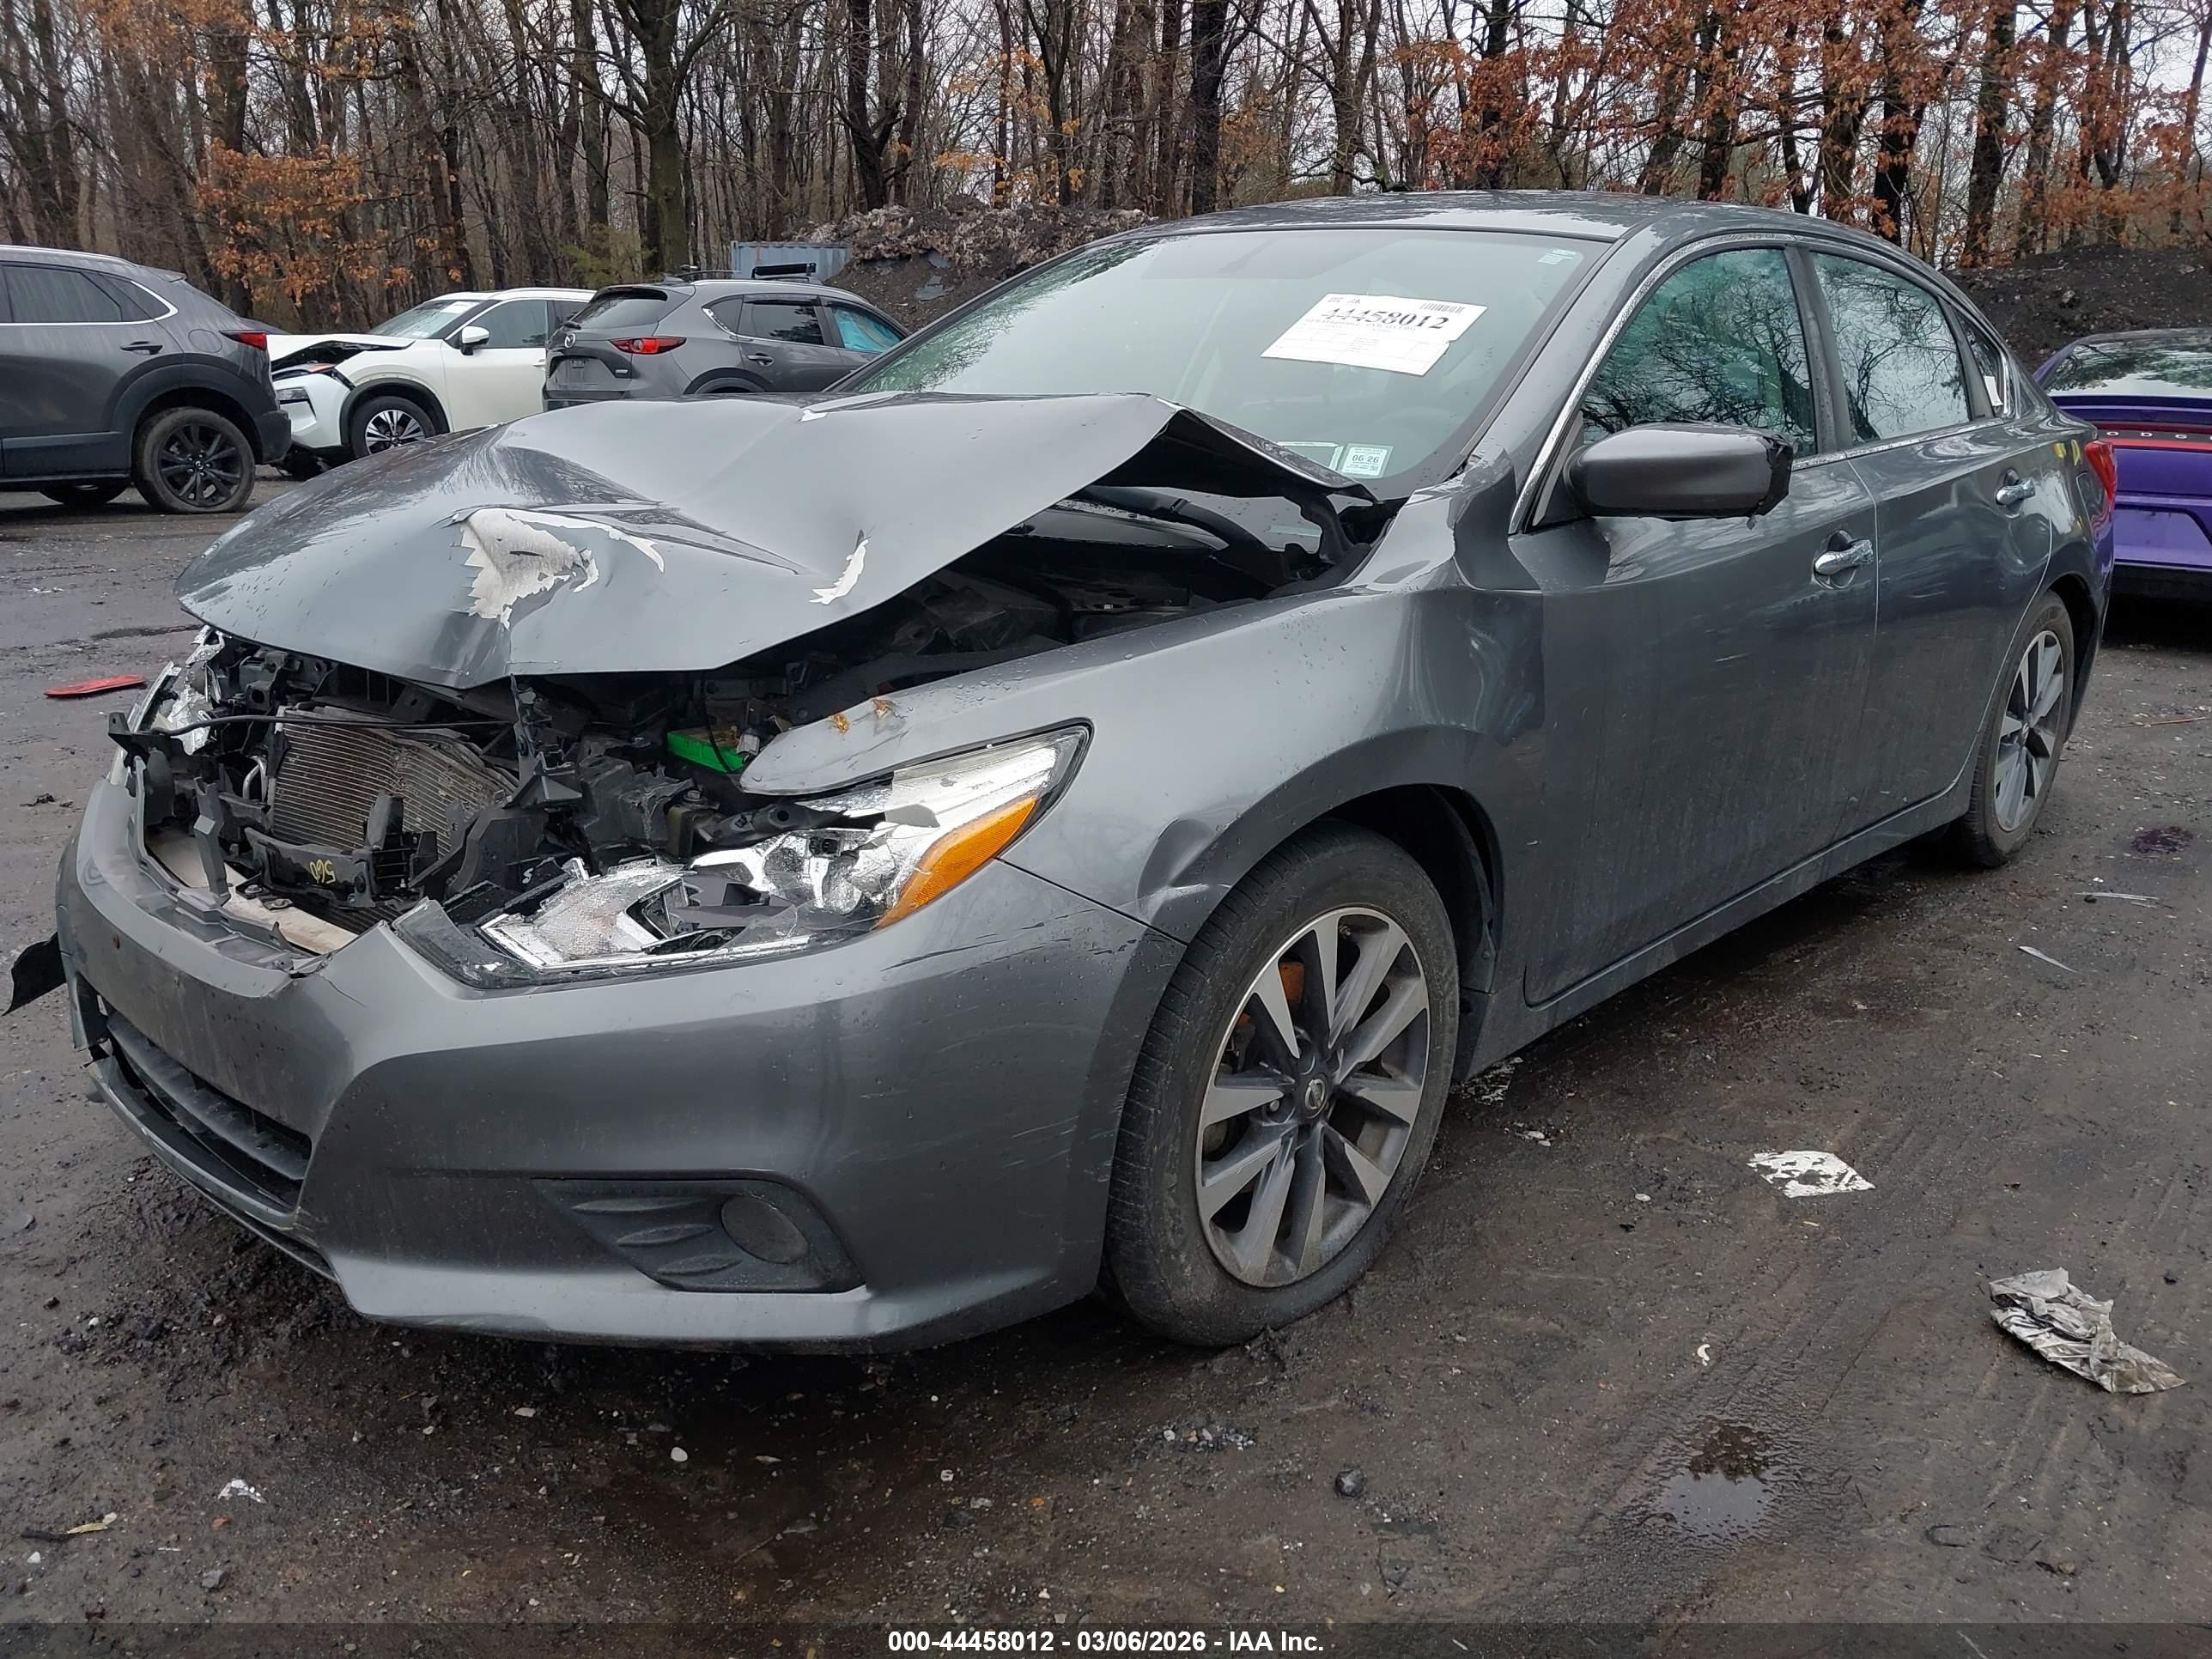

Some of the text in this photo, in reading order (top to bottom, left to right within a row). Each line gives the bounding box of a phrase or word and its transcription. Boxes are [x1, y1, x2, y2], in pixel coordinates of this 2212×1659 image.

[1321, 307, 1449, 330] 44458012
[2106, 431, 2212, 441] ODG
[1367, 455, 1380, 464] 26
